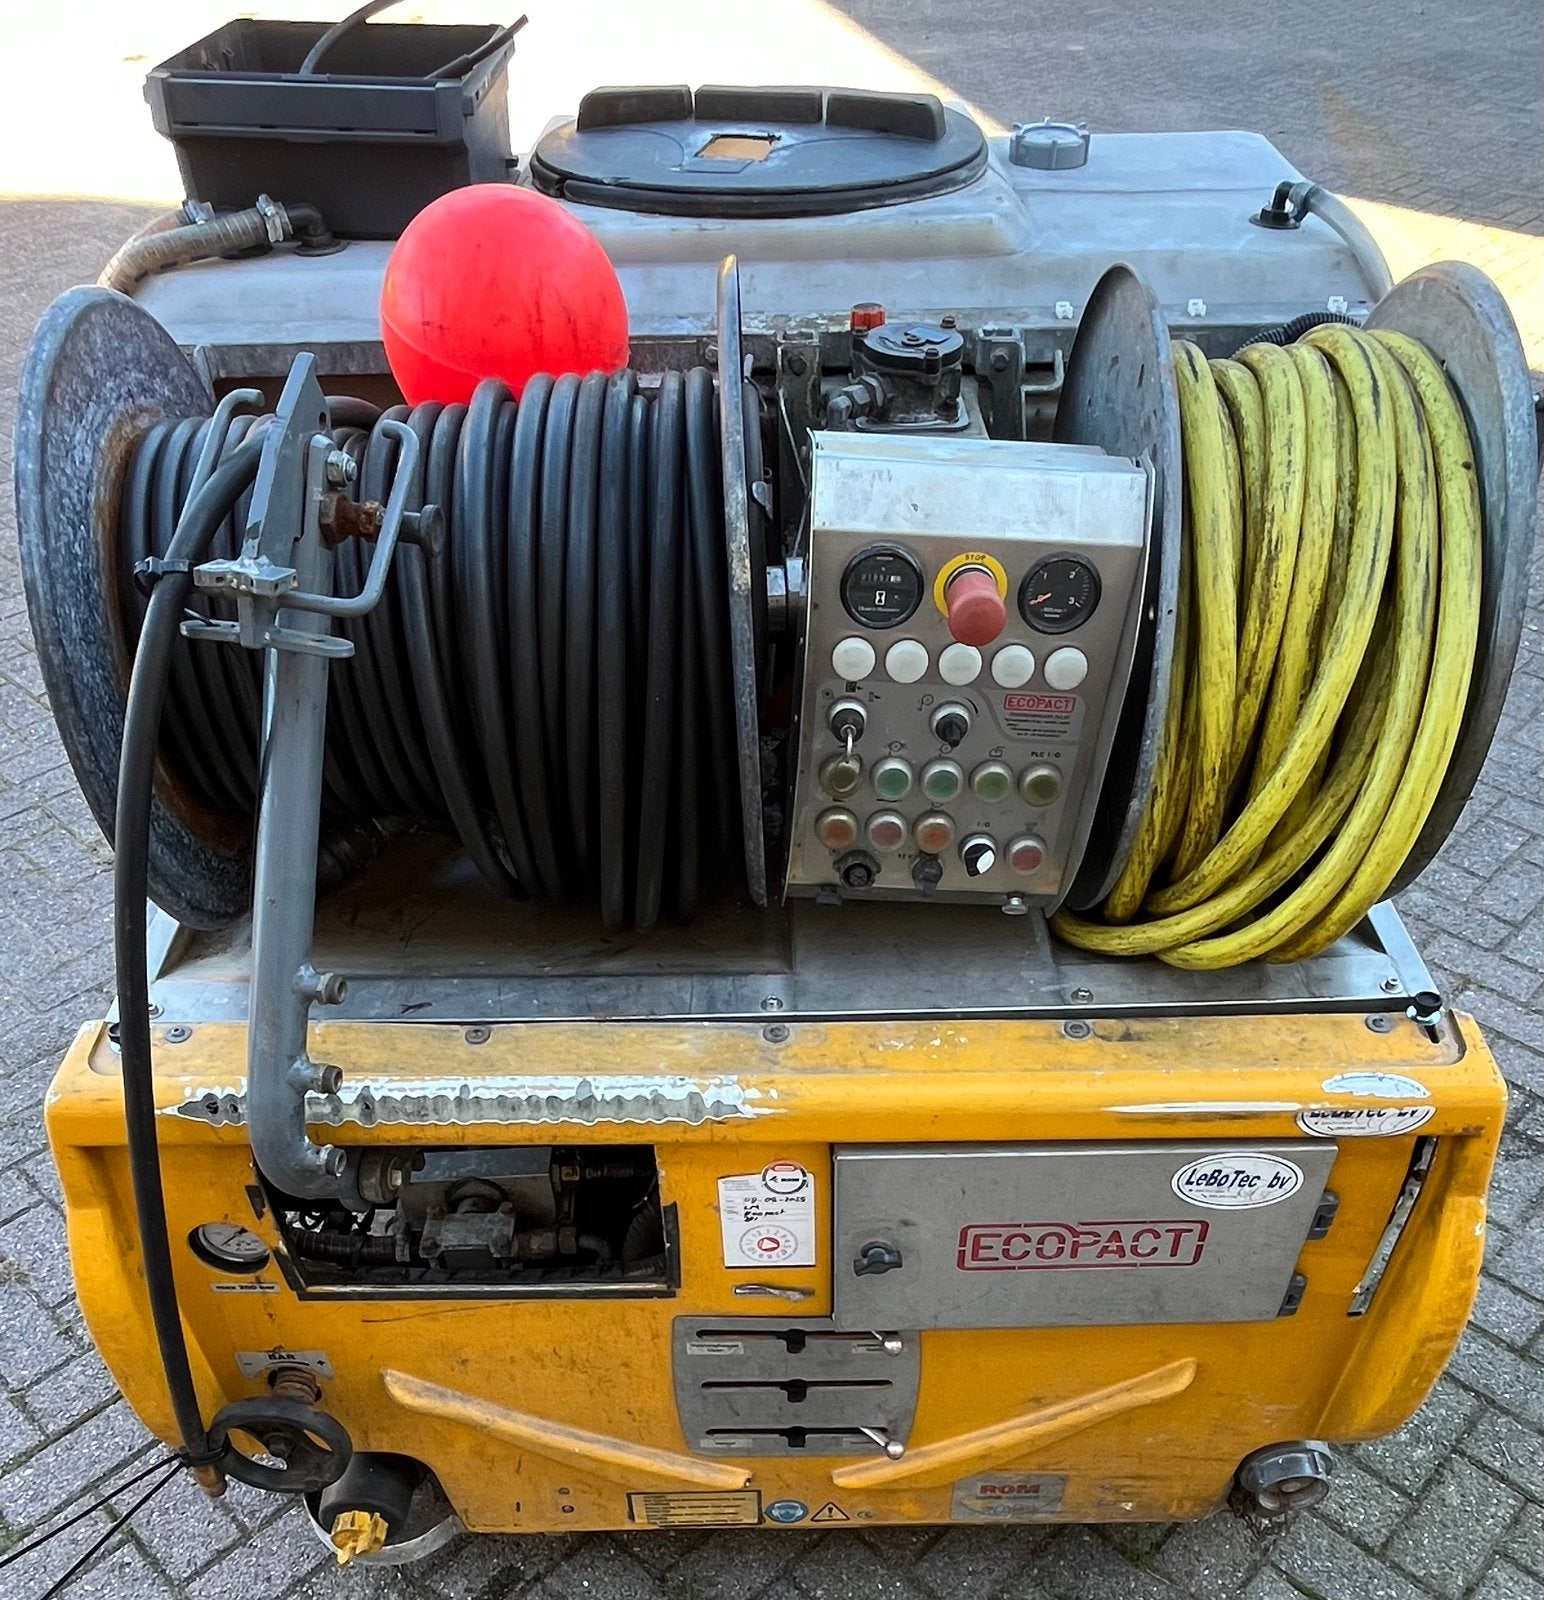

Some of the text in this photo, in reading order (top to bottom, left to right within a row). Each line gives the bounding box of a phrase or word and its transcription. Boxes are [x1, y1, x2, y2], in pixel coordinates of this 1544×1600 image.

[964, 554, 987, 562] STOP
[1068, 596, 1075, 605] 3
[1006, 696, 1072, 711] ECOPACT
[1184, 1168, 1293, 1189] LeBoTec bv
[971, 1228, 1194, 1261] ECOPACT
[980, 1484, 1041, 1494] ROM
